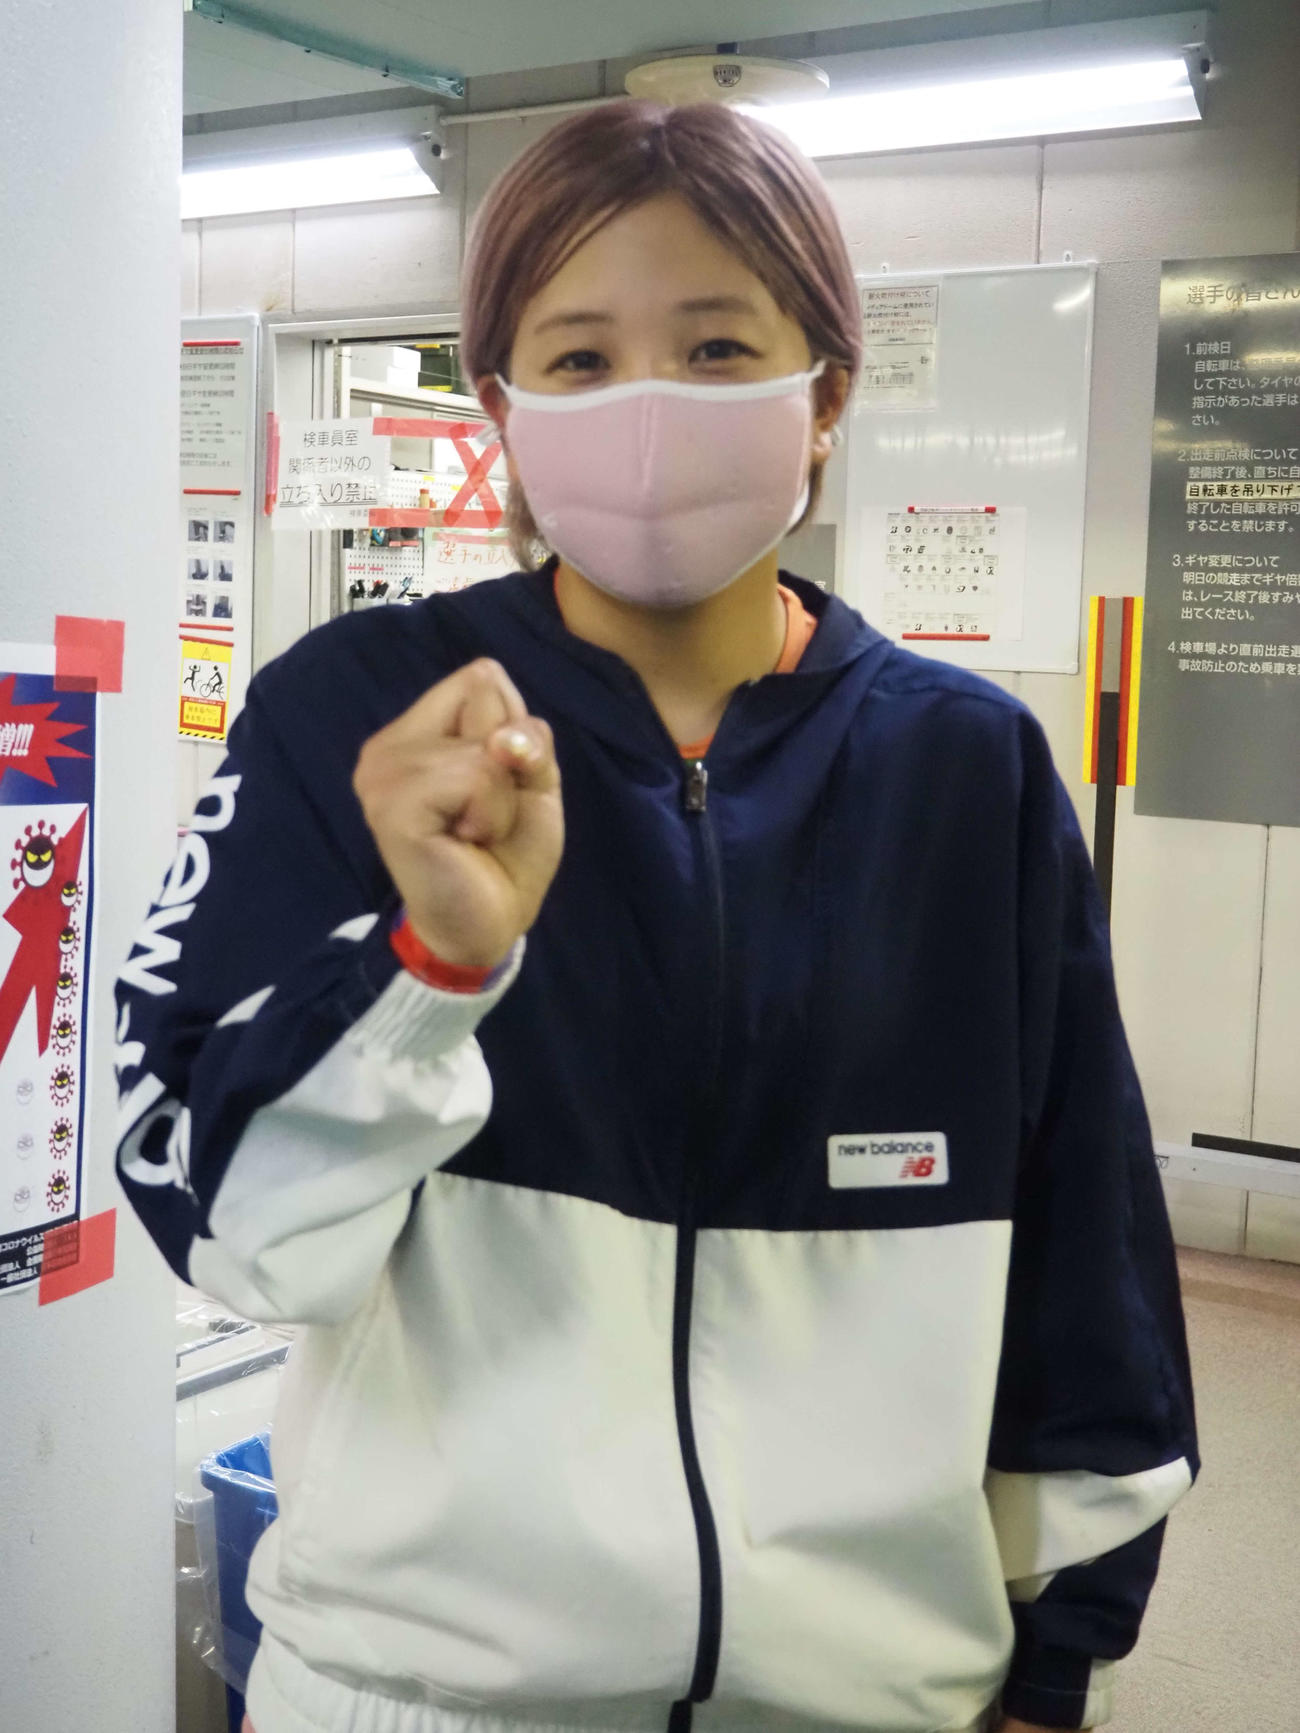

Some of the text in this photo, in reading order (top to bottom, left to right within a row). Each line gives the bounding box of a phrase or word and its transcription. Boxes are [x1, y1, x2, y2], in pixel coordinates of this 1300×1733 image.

[1192, 393, 1299, 409] 指示があった選手は
[1191, 415, 1220, 426] さい。
[303, 430, 358, 447] 検車員室
[1186, 520, 1294, 532] することを禁じます。
[1181, 607, 1255, 621] 出てください。
[1178, 659, 1300, 675] 事故防止のため乗車を
[838, 1140, 935, 1156] new balance
